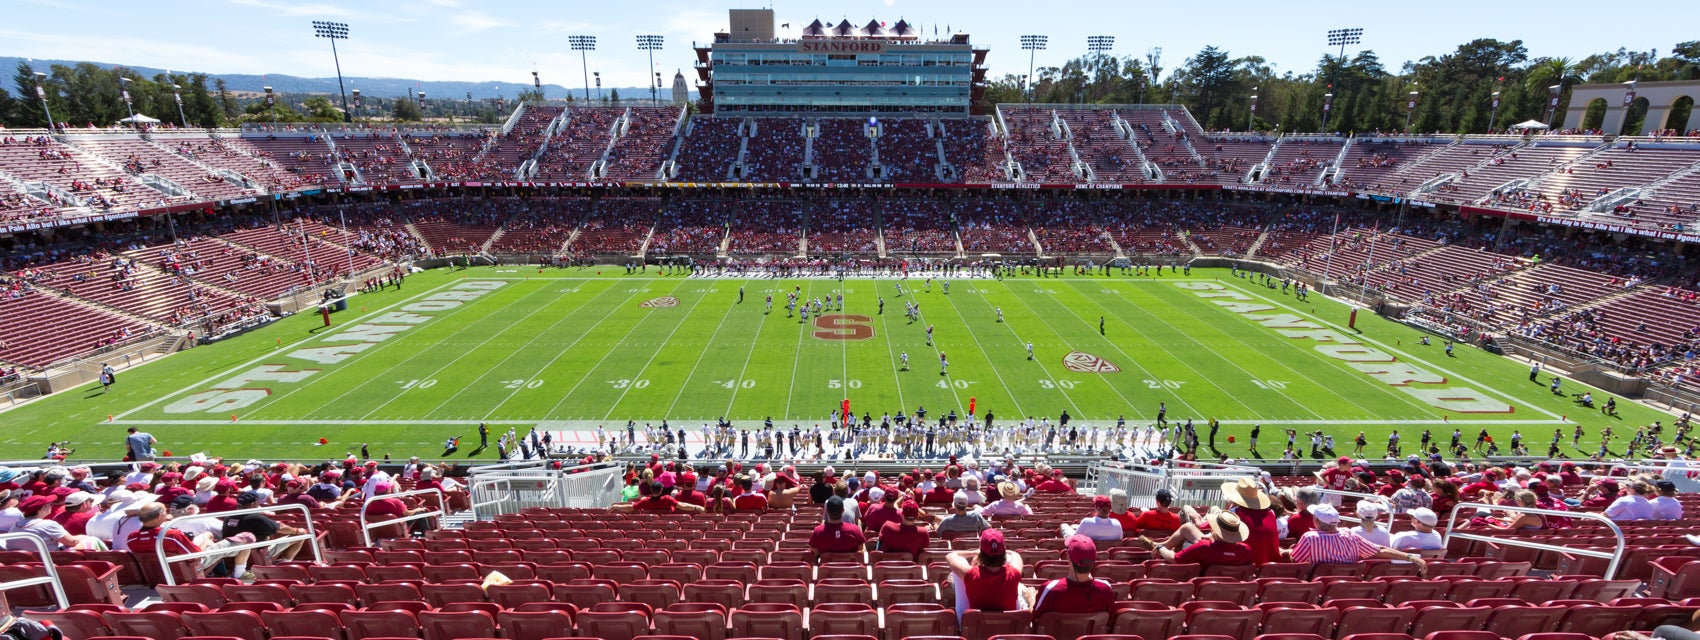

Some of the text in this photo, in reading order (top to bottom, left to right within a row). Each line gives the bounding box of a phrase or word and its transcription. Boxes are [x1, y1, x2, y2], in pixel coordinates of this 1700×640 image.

[803, 42, 880, 52] STANFORD
[163, 280, 510, 414] STANFORD
[812, 314, 876, 340] S
[1173, 281, 1514, 414] STANFORD
